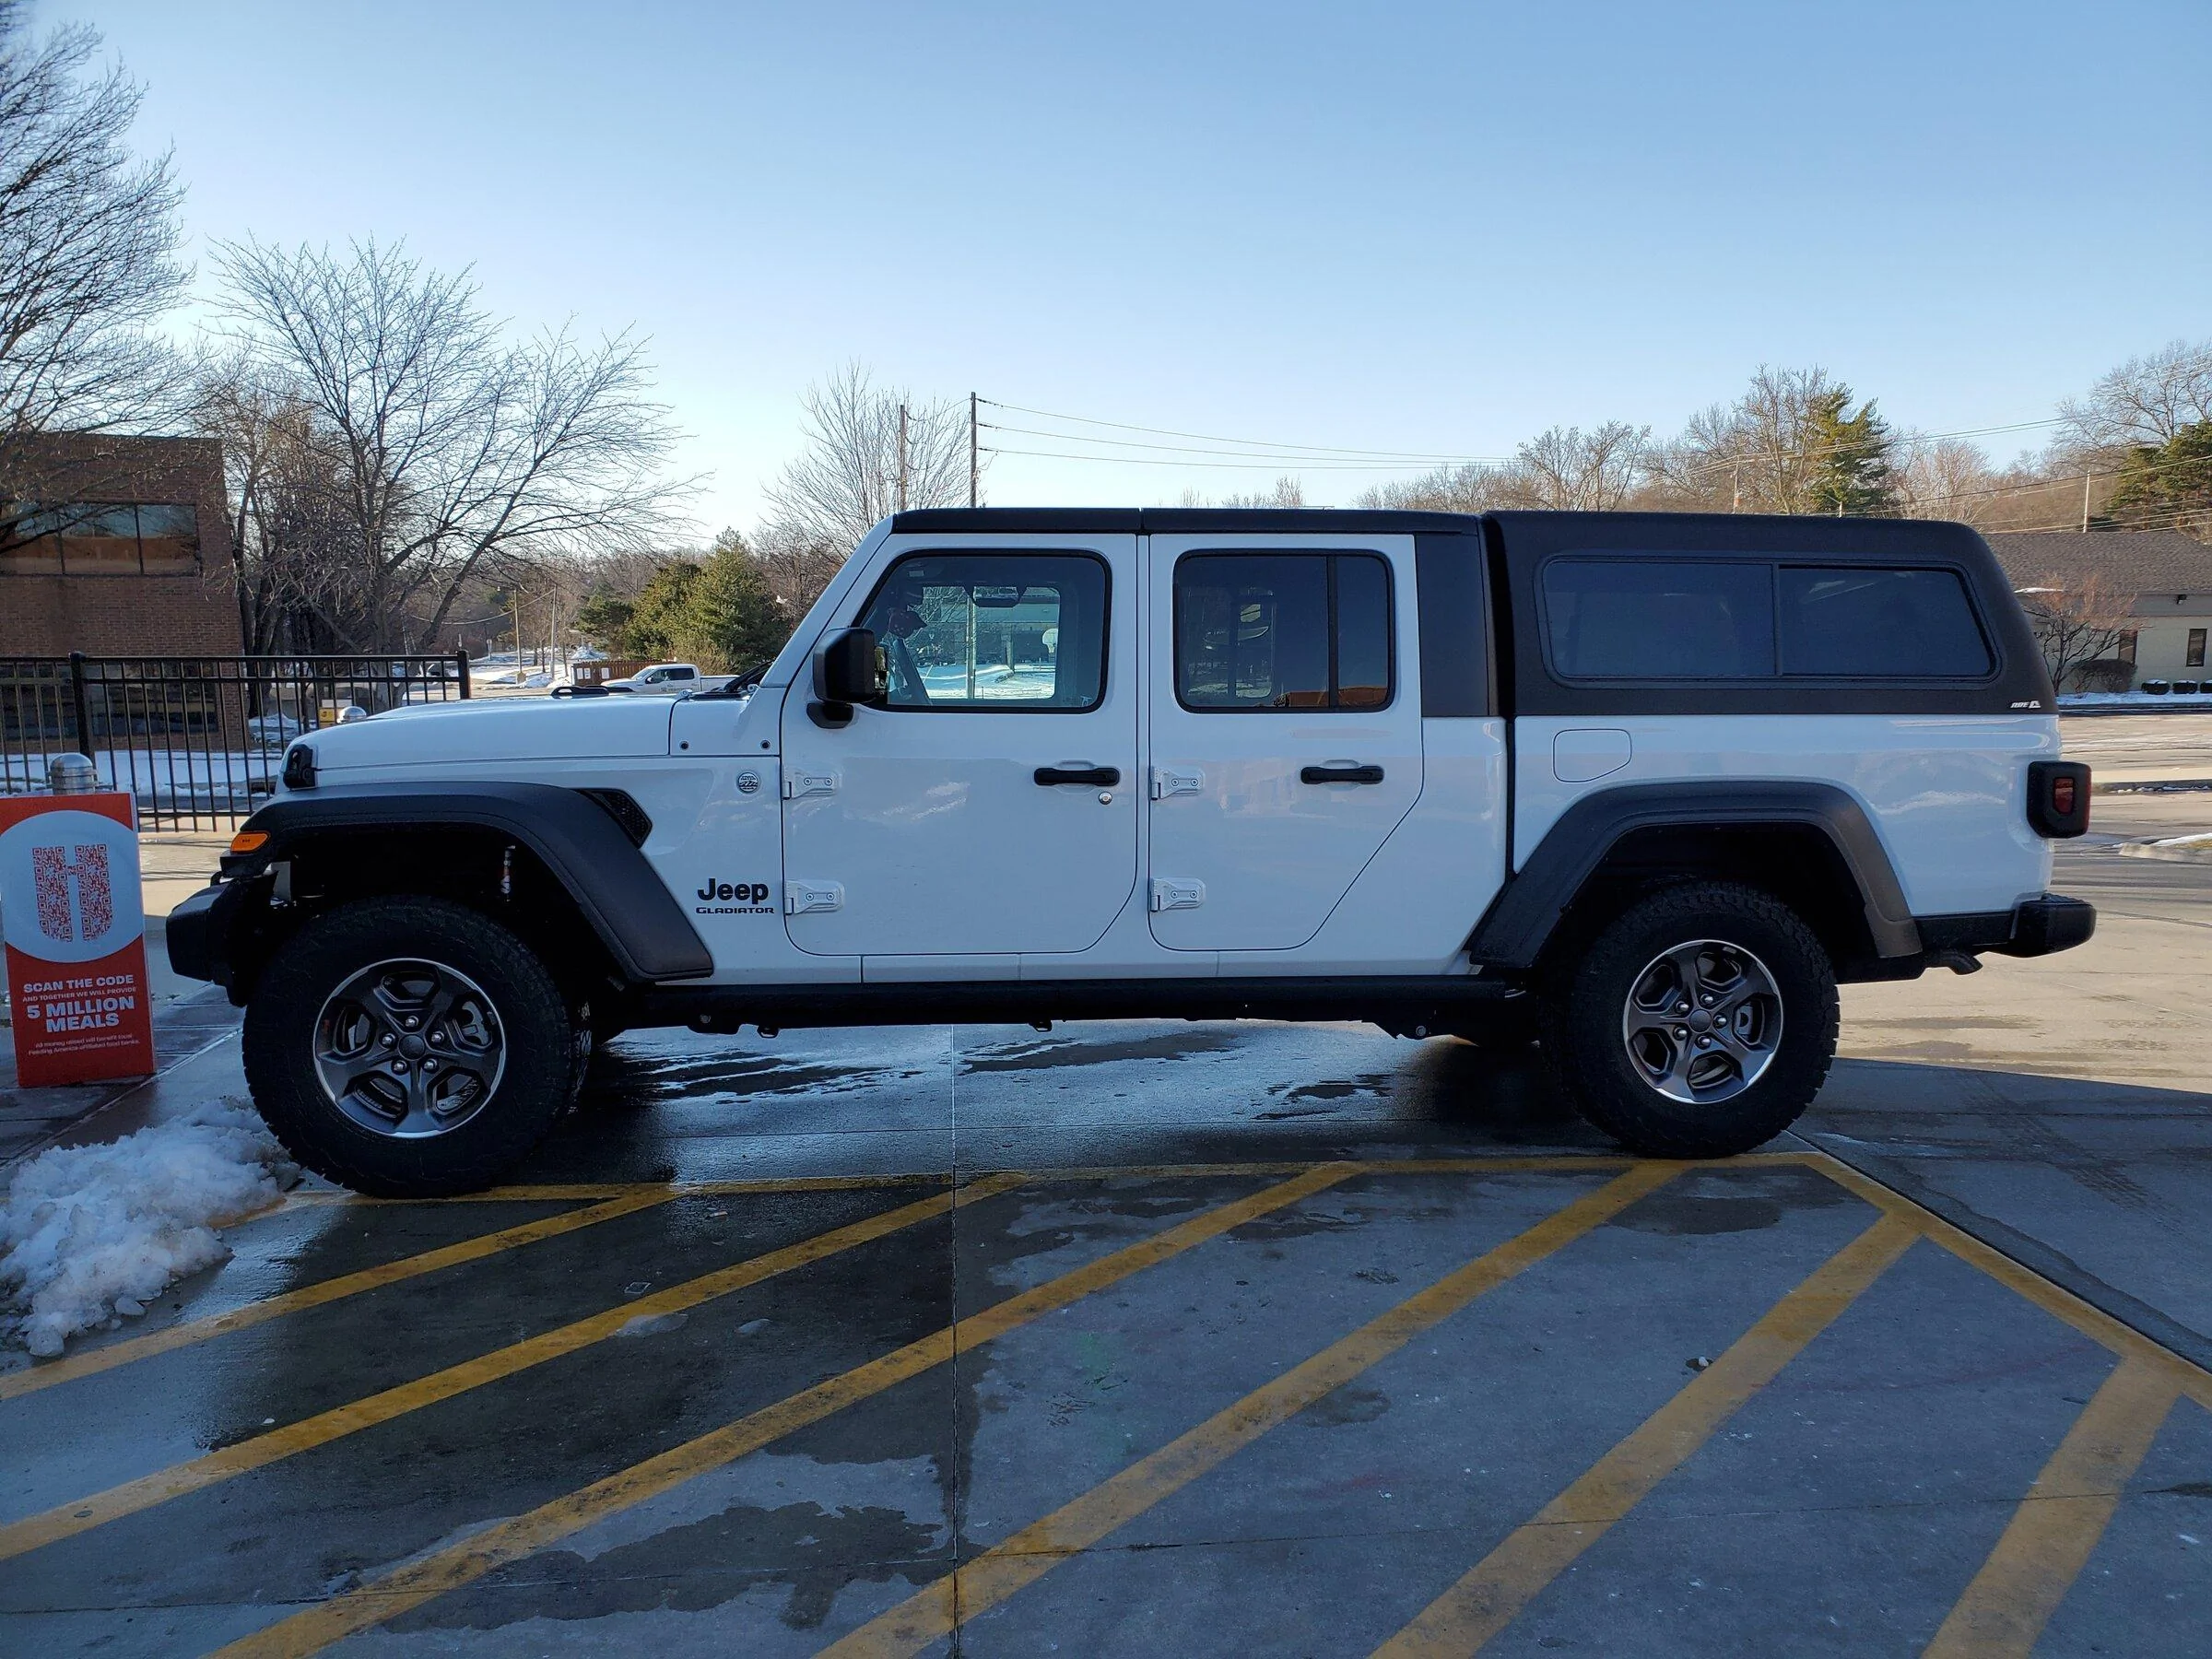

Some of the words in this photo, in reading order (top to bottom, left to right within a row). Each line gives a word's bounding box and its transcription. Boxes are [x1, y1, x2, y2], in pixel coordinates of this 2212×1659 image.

[697, 877, 769, 905] Jeep
[23, 981, 64, 993] SCAN
[66, 978, 93, 989] THE
[96, 974, 135, 986] CODE
[39, 992, 75, 1001] TOGETHER
[107, 986, 136, 994] PROVIDE
[27, 1005, 41, 1018] 5
[46, 995, 135, 1017] MILLION
[46, 1013, 120, 1032] MEALS
